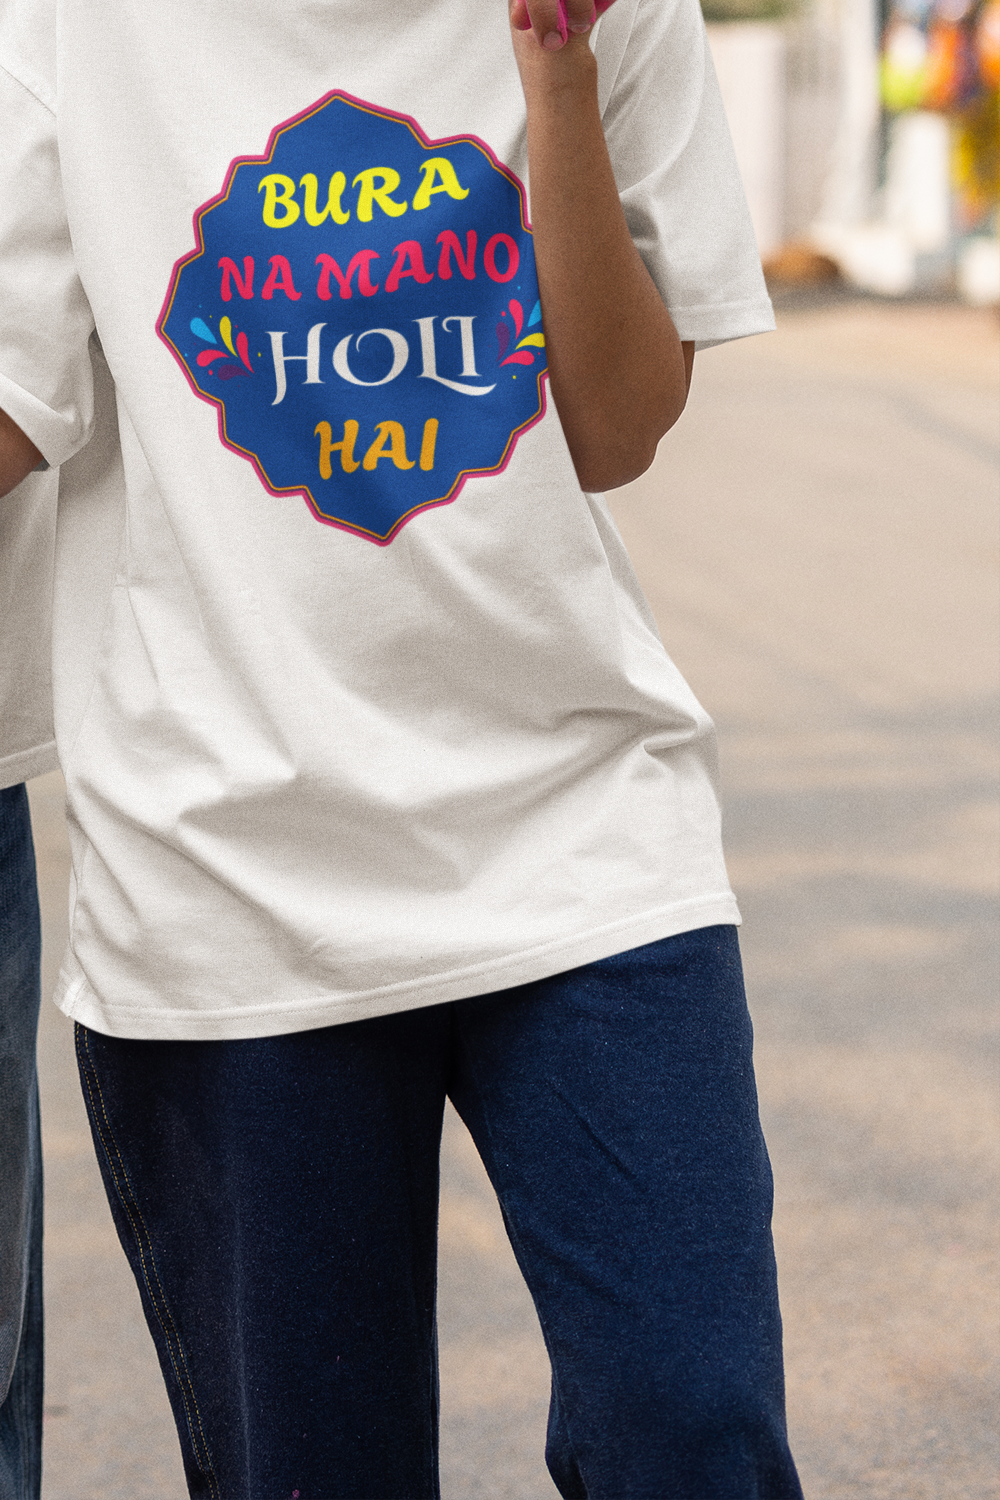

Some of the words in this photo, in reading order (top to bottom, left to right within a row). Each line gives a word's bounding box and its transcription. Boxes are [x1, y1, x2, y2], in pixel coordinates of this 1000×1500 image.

[258, 157, 470, 229] BURA
[217, 255, 302, 302] NA
[315, 230, 520, 301] MANO
[265, 315, 497, 406] HOLI
[314, 417, 439, 480] HAI
